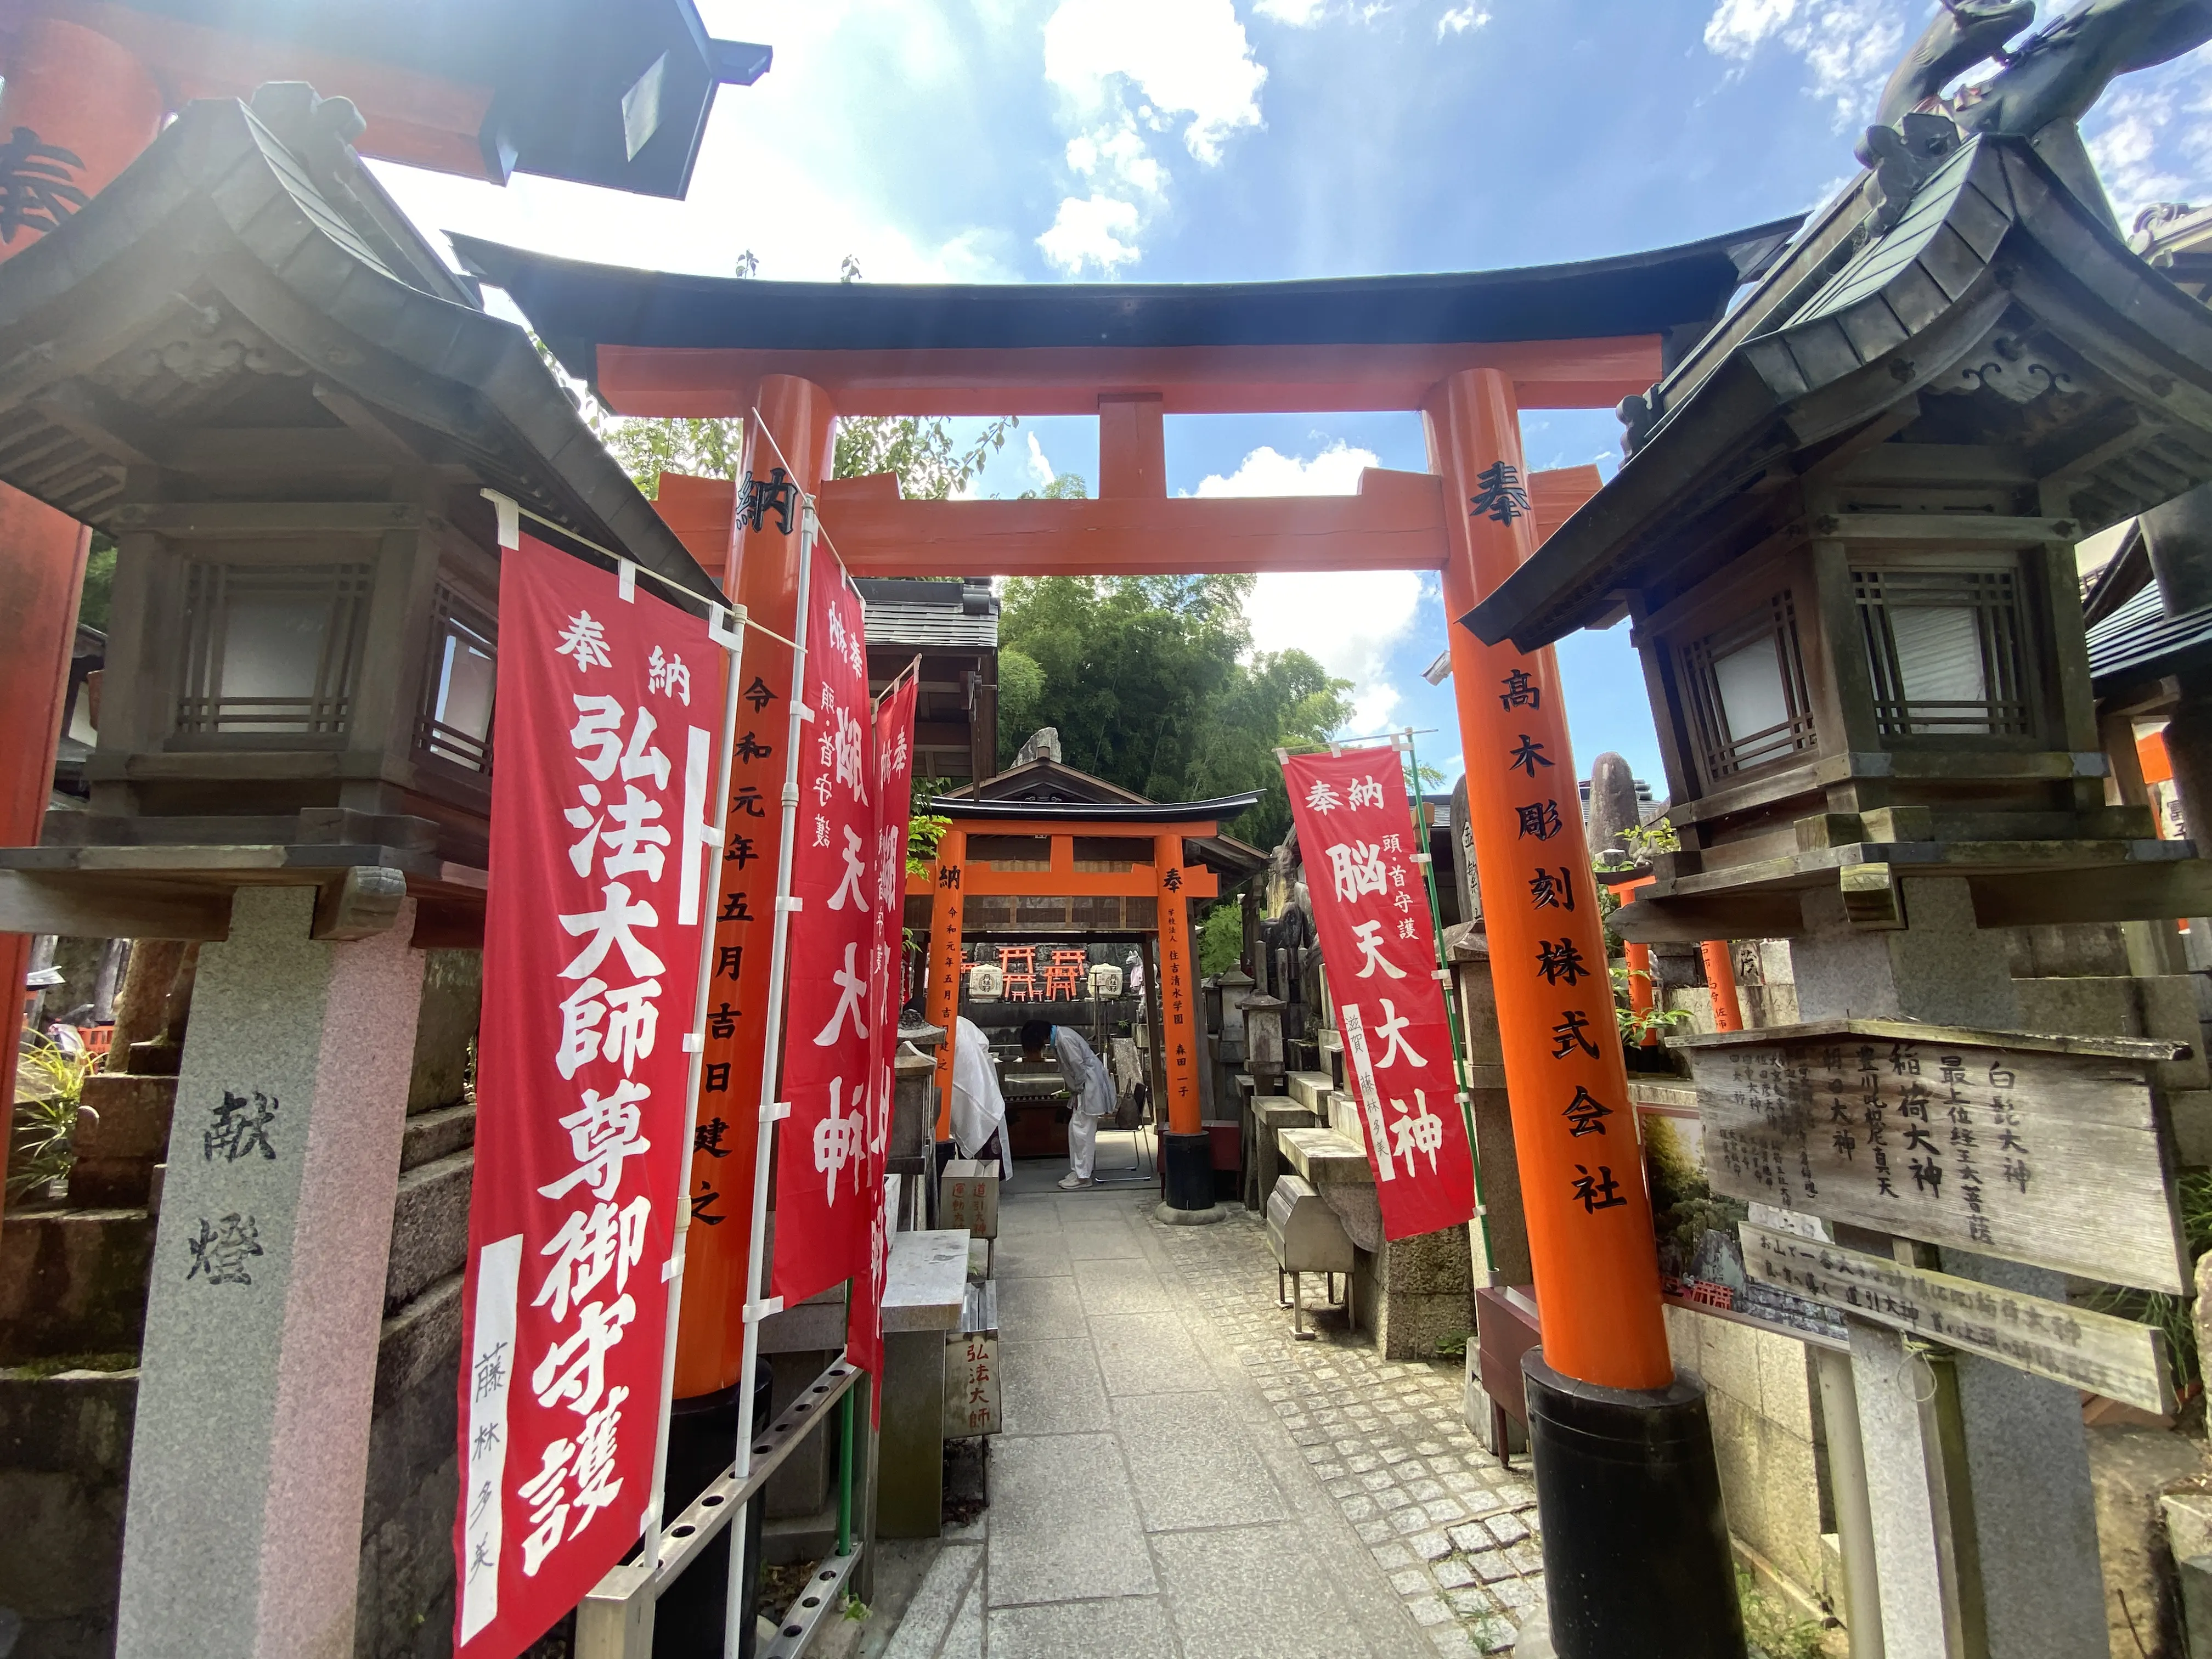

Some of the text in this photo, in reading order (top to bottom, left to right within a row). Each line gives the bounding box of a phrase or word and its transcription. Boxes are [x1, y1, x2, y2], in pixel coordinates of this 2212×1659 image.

[736, 467, 798, 535] 納
[1470, 460, 1531, 527] 奉
[555, 610, 691, 706] 奉納
[1305, 775, 1384, 816] 奉納
[939, 865, 961, 889] 納
[1163, 867, 1183, 893] 奉
[690, 677, 778, 1226] 令和元年五月吉日建之
[1325, 839, 1443, 1178] 脳天大神
[1346, 1014, 1363, 1053] 滋賀
[517, 694, 671, 1577] 弘法大師尊御守護
[1889, 1043, 1942, 1199] 稲荷大神
[187, 1091, 279, 1286] 献燈
[966, 1344, 990, 1427] 弘法大師
